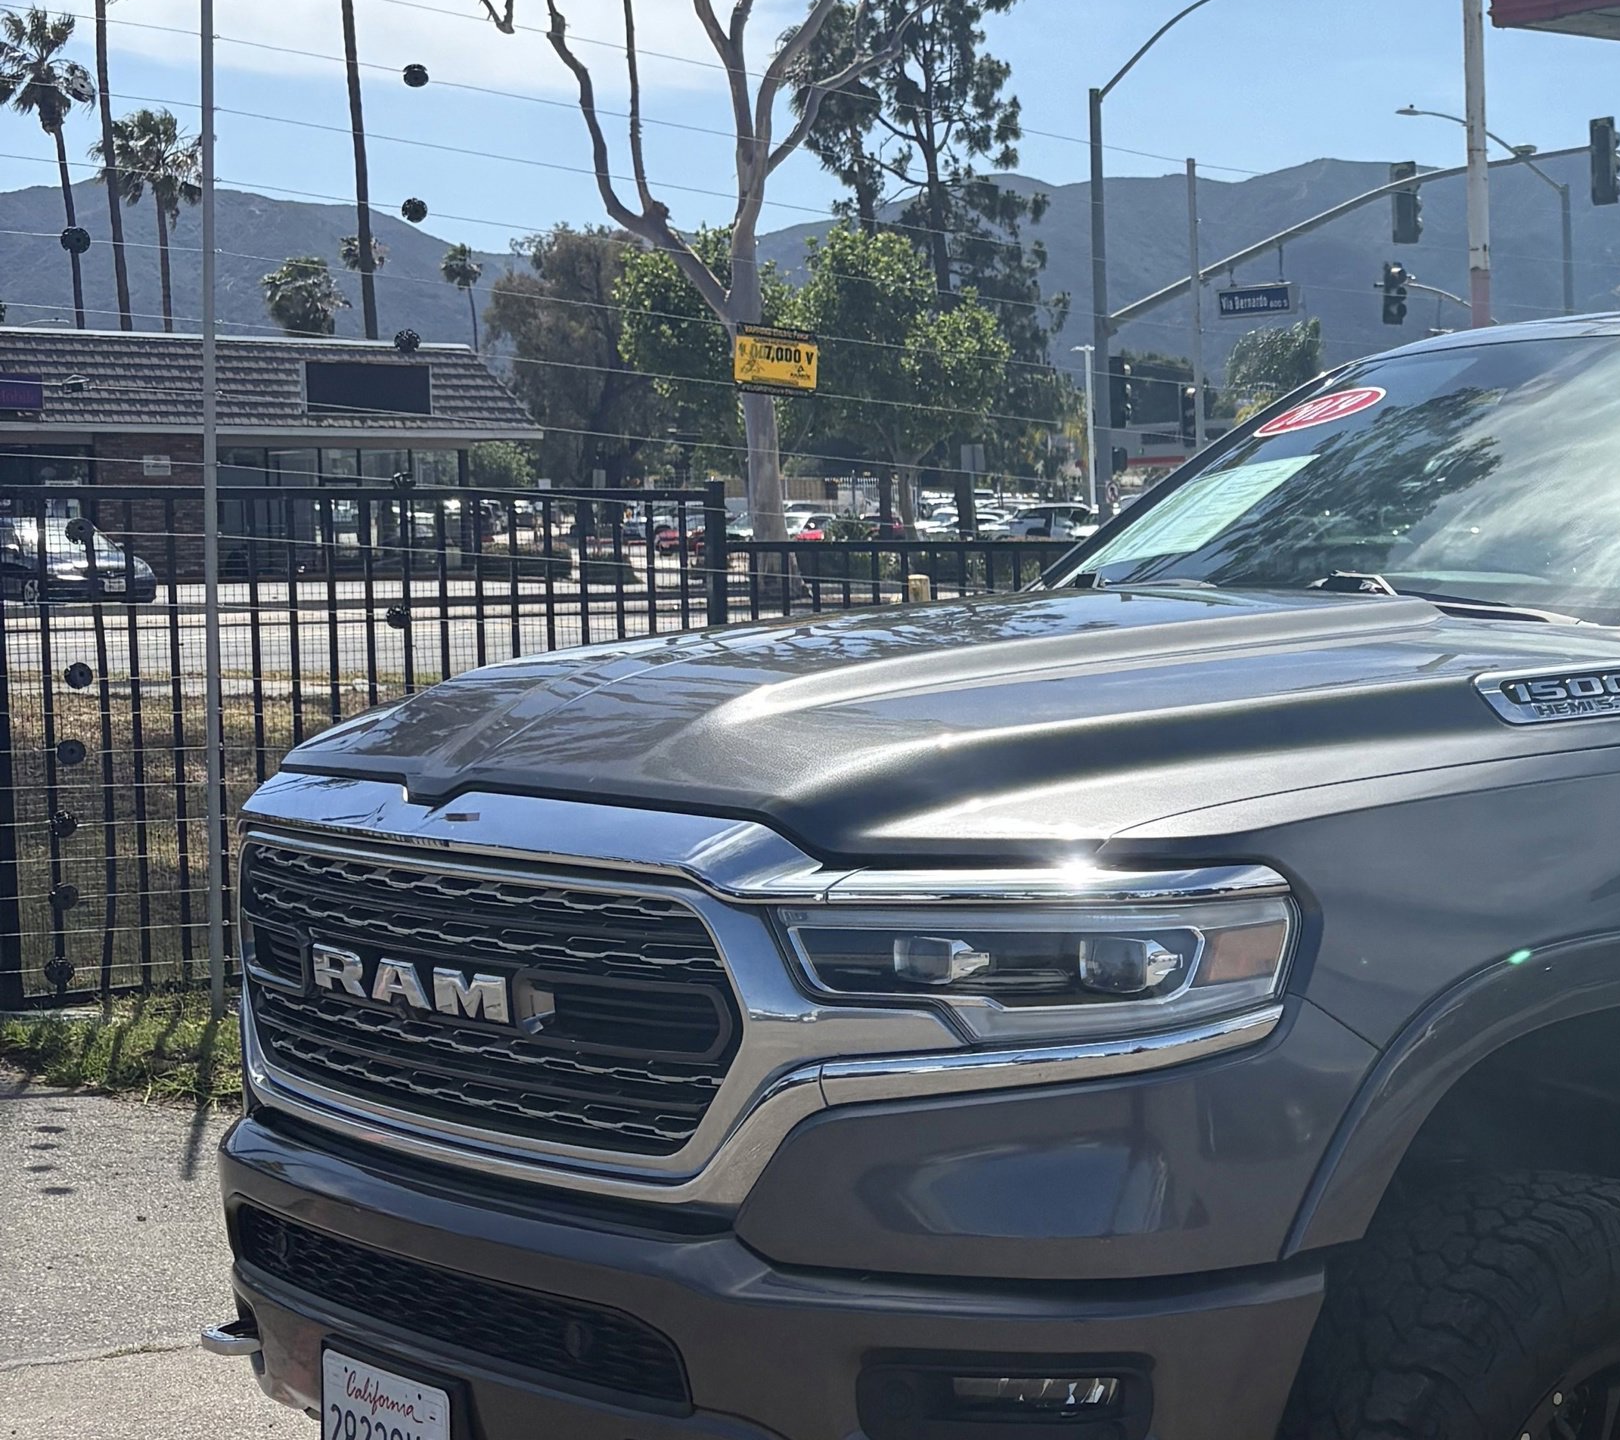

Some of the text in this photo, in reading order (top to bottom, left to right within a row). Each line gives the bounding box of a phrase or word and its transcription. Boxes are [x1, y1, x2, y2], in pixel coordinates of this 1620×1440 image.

[805, 351, 814, 365] V
[1531, 700, 1593, 718] HEMI
[312, 943, 510, 1024] RAM
[346, 1370, 423, 1423] California
